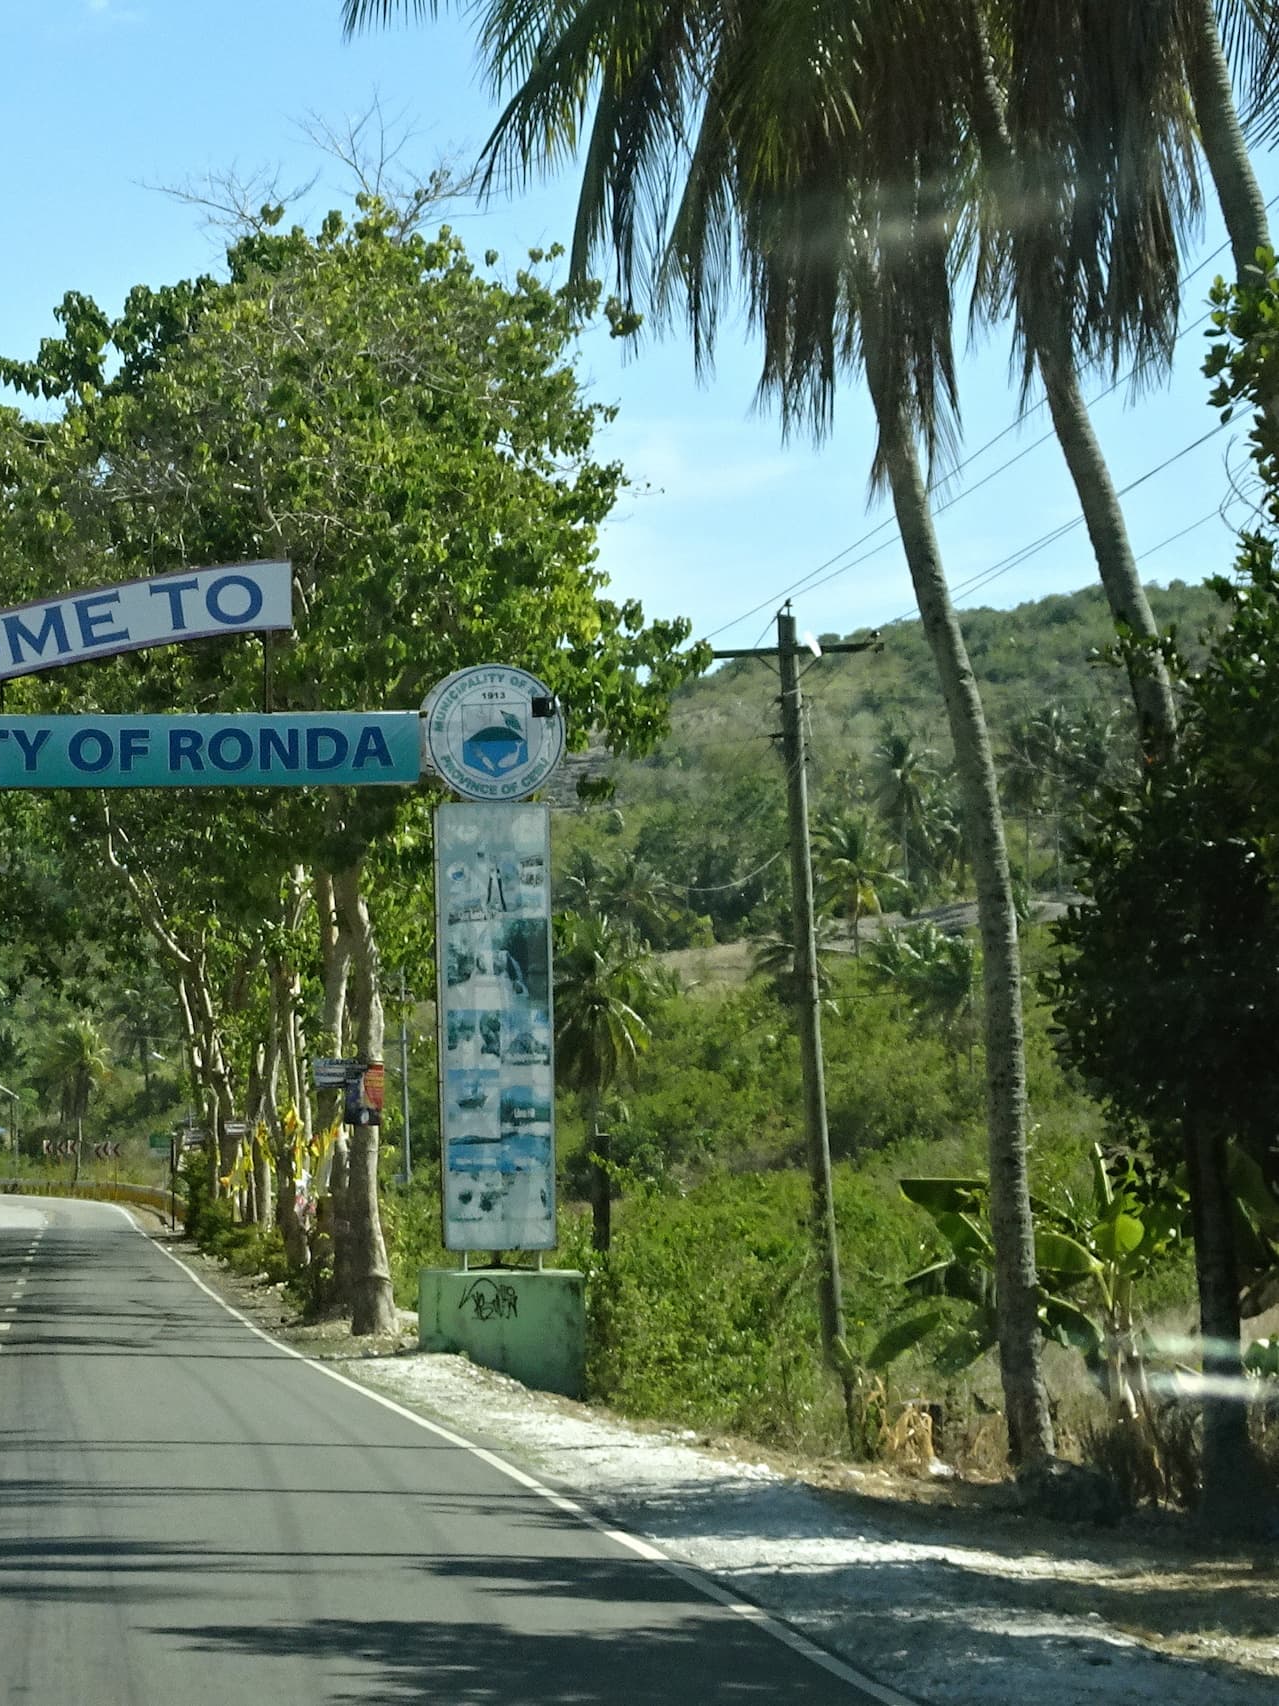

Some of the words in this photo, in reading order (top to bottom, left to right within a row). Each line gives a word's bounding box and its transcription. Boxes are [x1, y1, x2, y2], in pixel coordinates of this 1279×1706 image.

[149, 575, 263, 630] TO
[434, 673, 505, 732] MUNICIPALITY
[510, 676, 528, 688] OF
[68, 728, 150, 772] OF
[168, 726, 395, 771] RONDA
[440, 755, 498, 795] PROVINCE
[501, 782, 517, 794] OF
